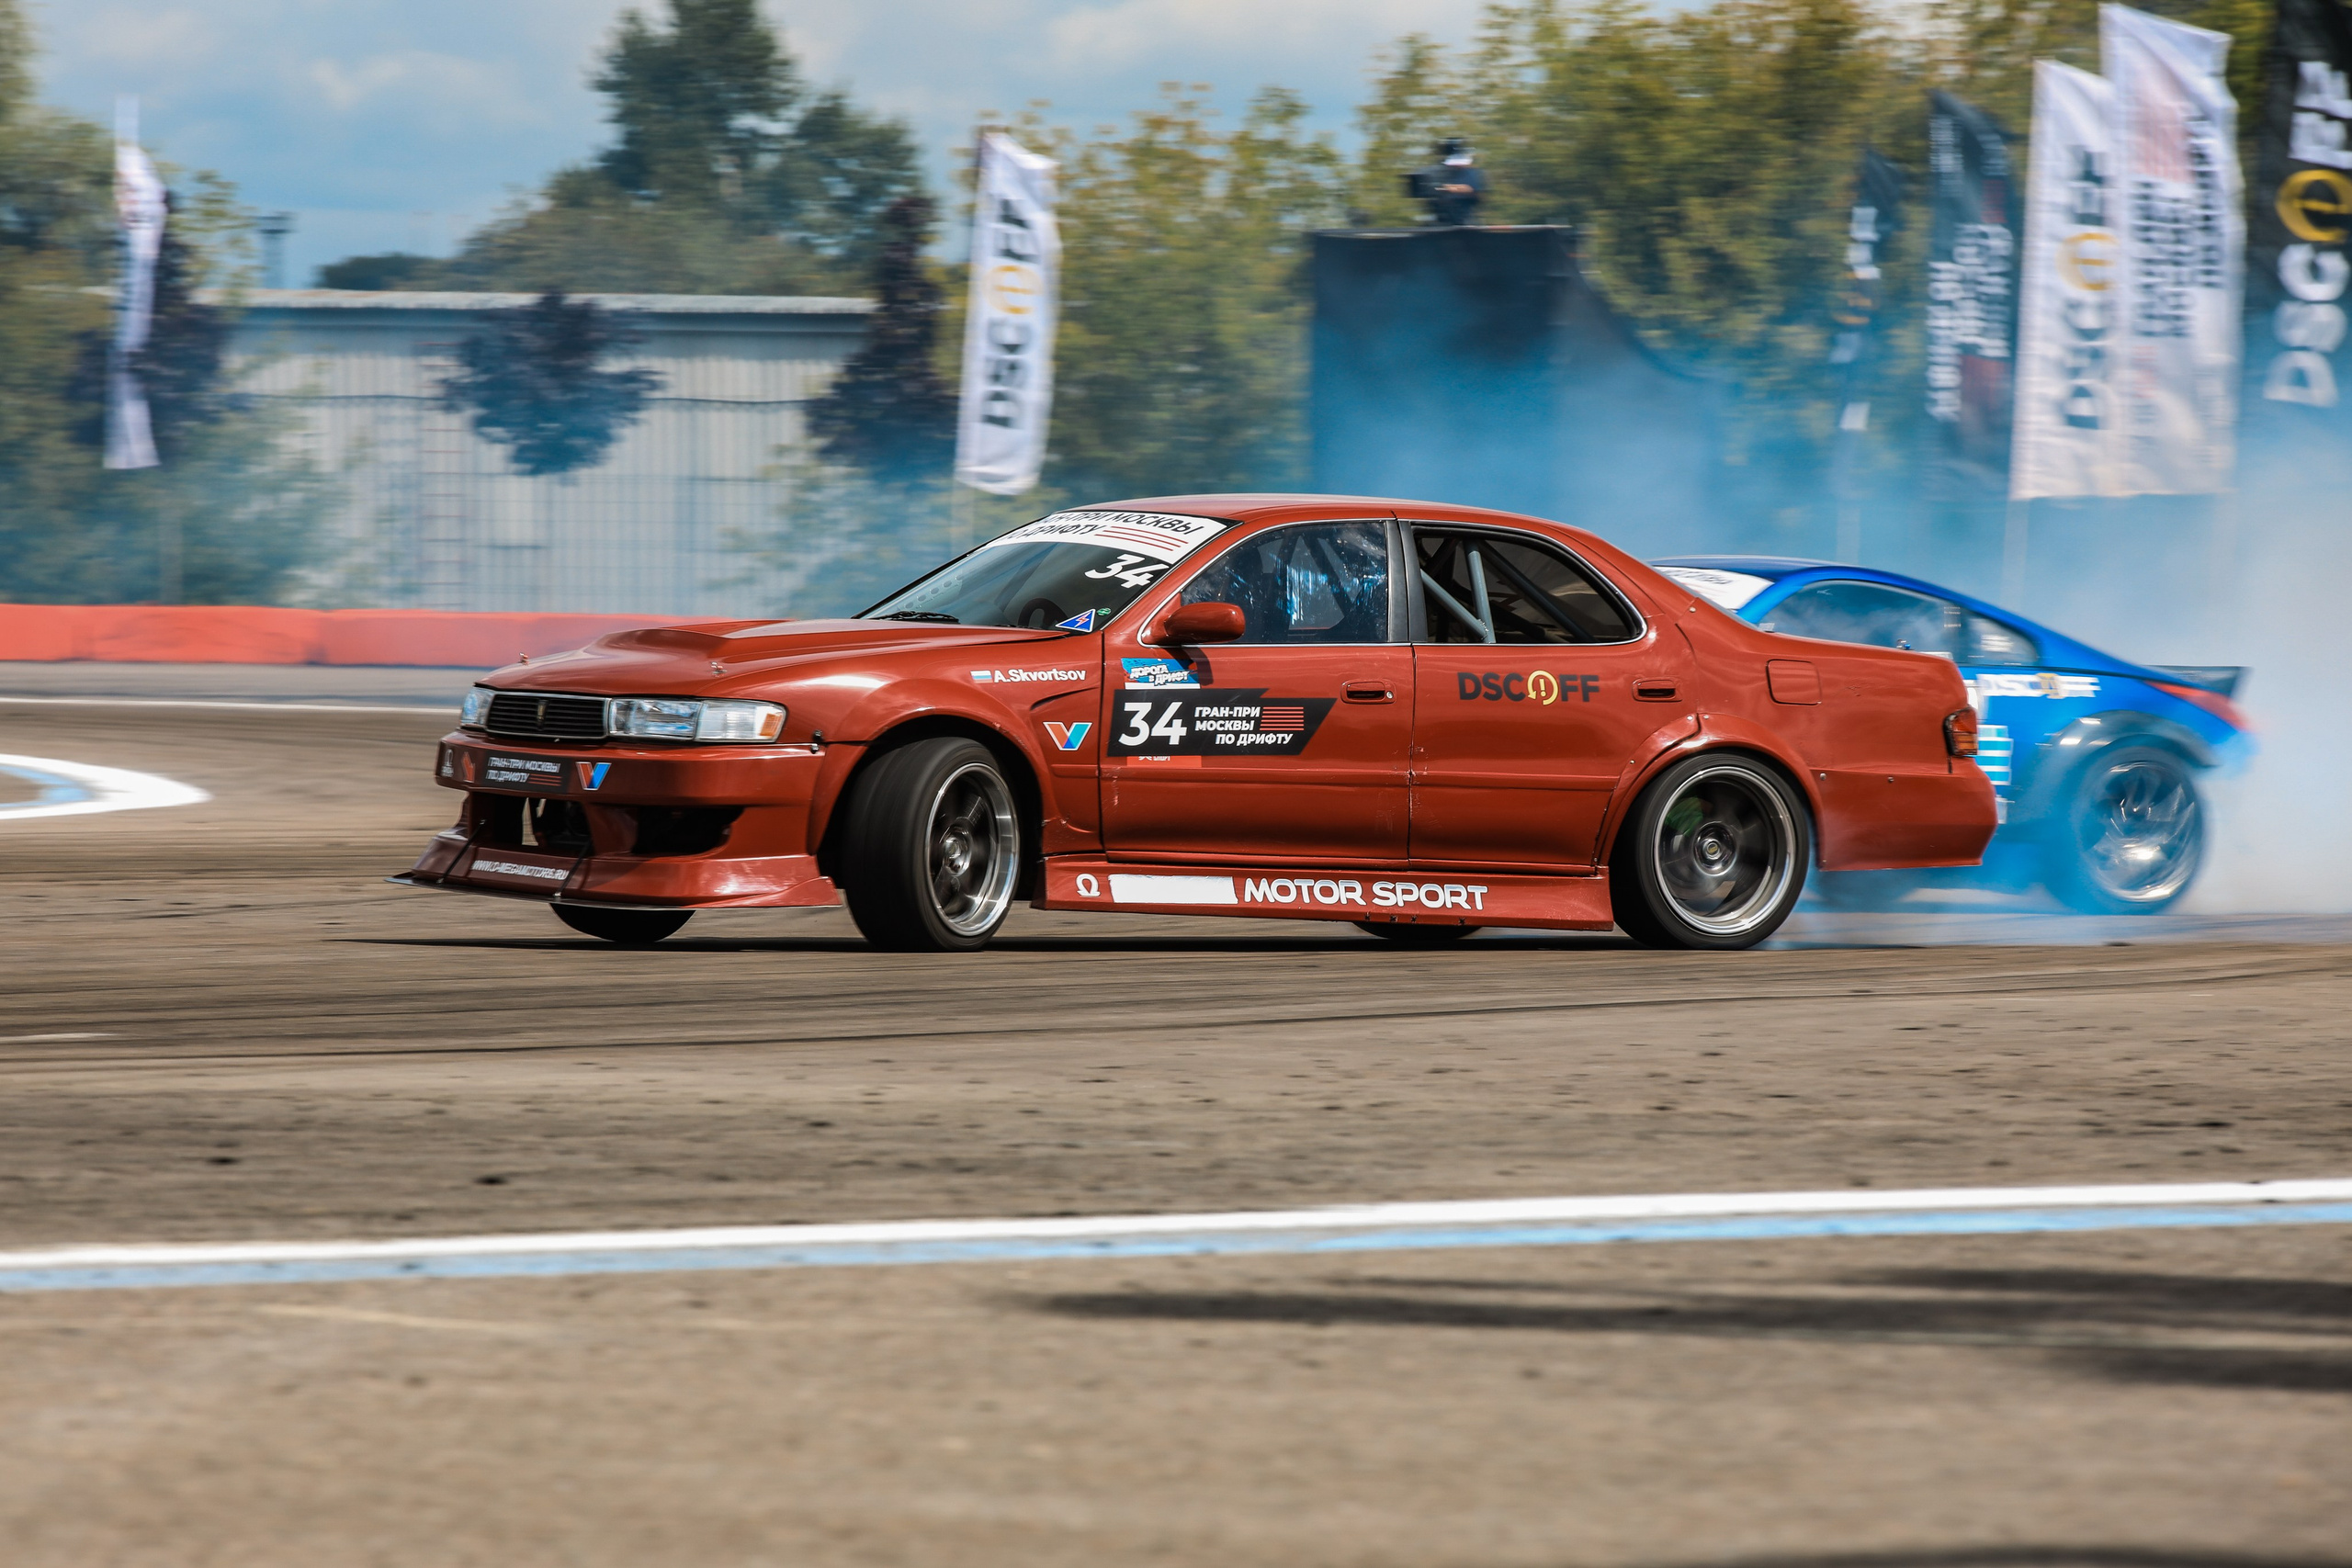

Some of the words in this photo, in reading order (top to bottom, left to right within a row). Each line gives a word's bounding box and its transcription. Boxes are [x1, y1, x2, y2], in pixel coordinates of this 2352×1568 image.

[1110, 513, 1204, 536] МОСКВЫ
[1084, 553, 1170, 589] 34
[993, 668, 1087, 683] A.Skvortsov
[1194, 706, 1261, 717] ГРАН-ПРИ
[1118, 701, 1188, 747] 34
[1195, 719, 1255, 731] МОСКВЫ
[1216, 733, 1236, 745] ПО
[1237, 733, 1294, 747] ДРИФТУ
[1244, 877, 1367, 906] MOTOR
[1372, 881, 1488, 910] SPORT
